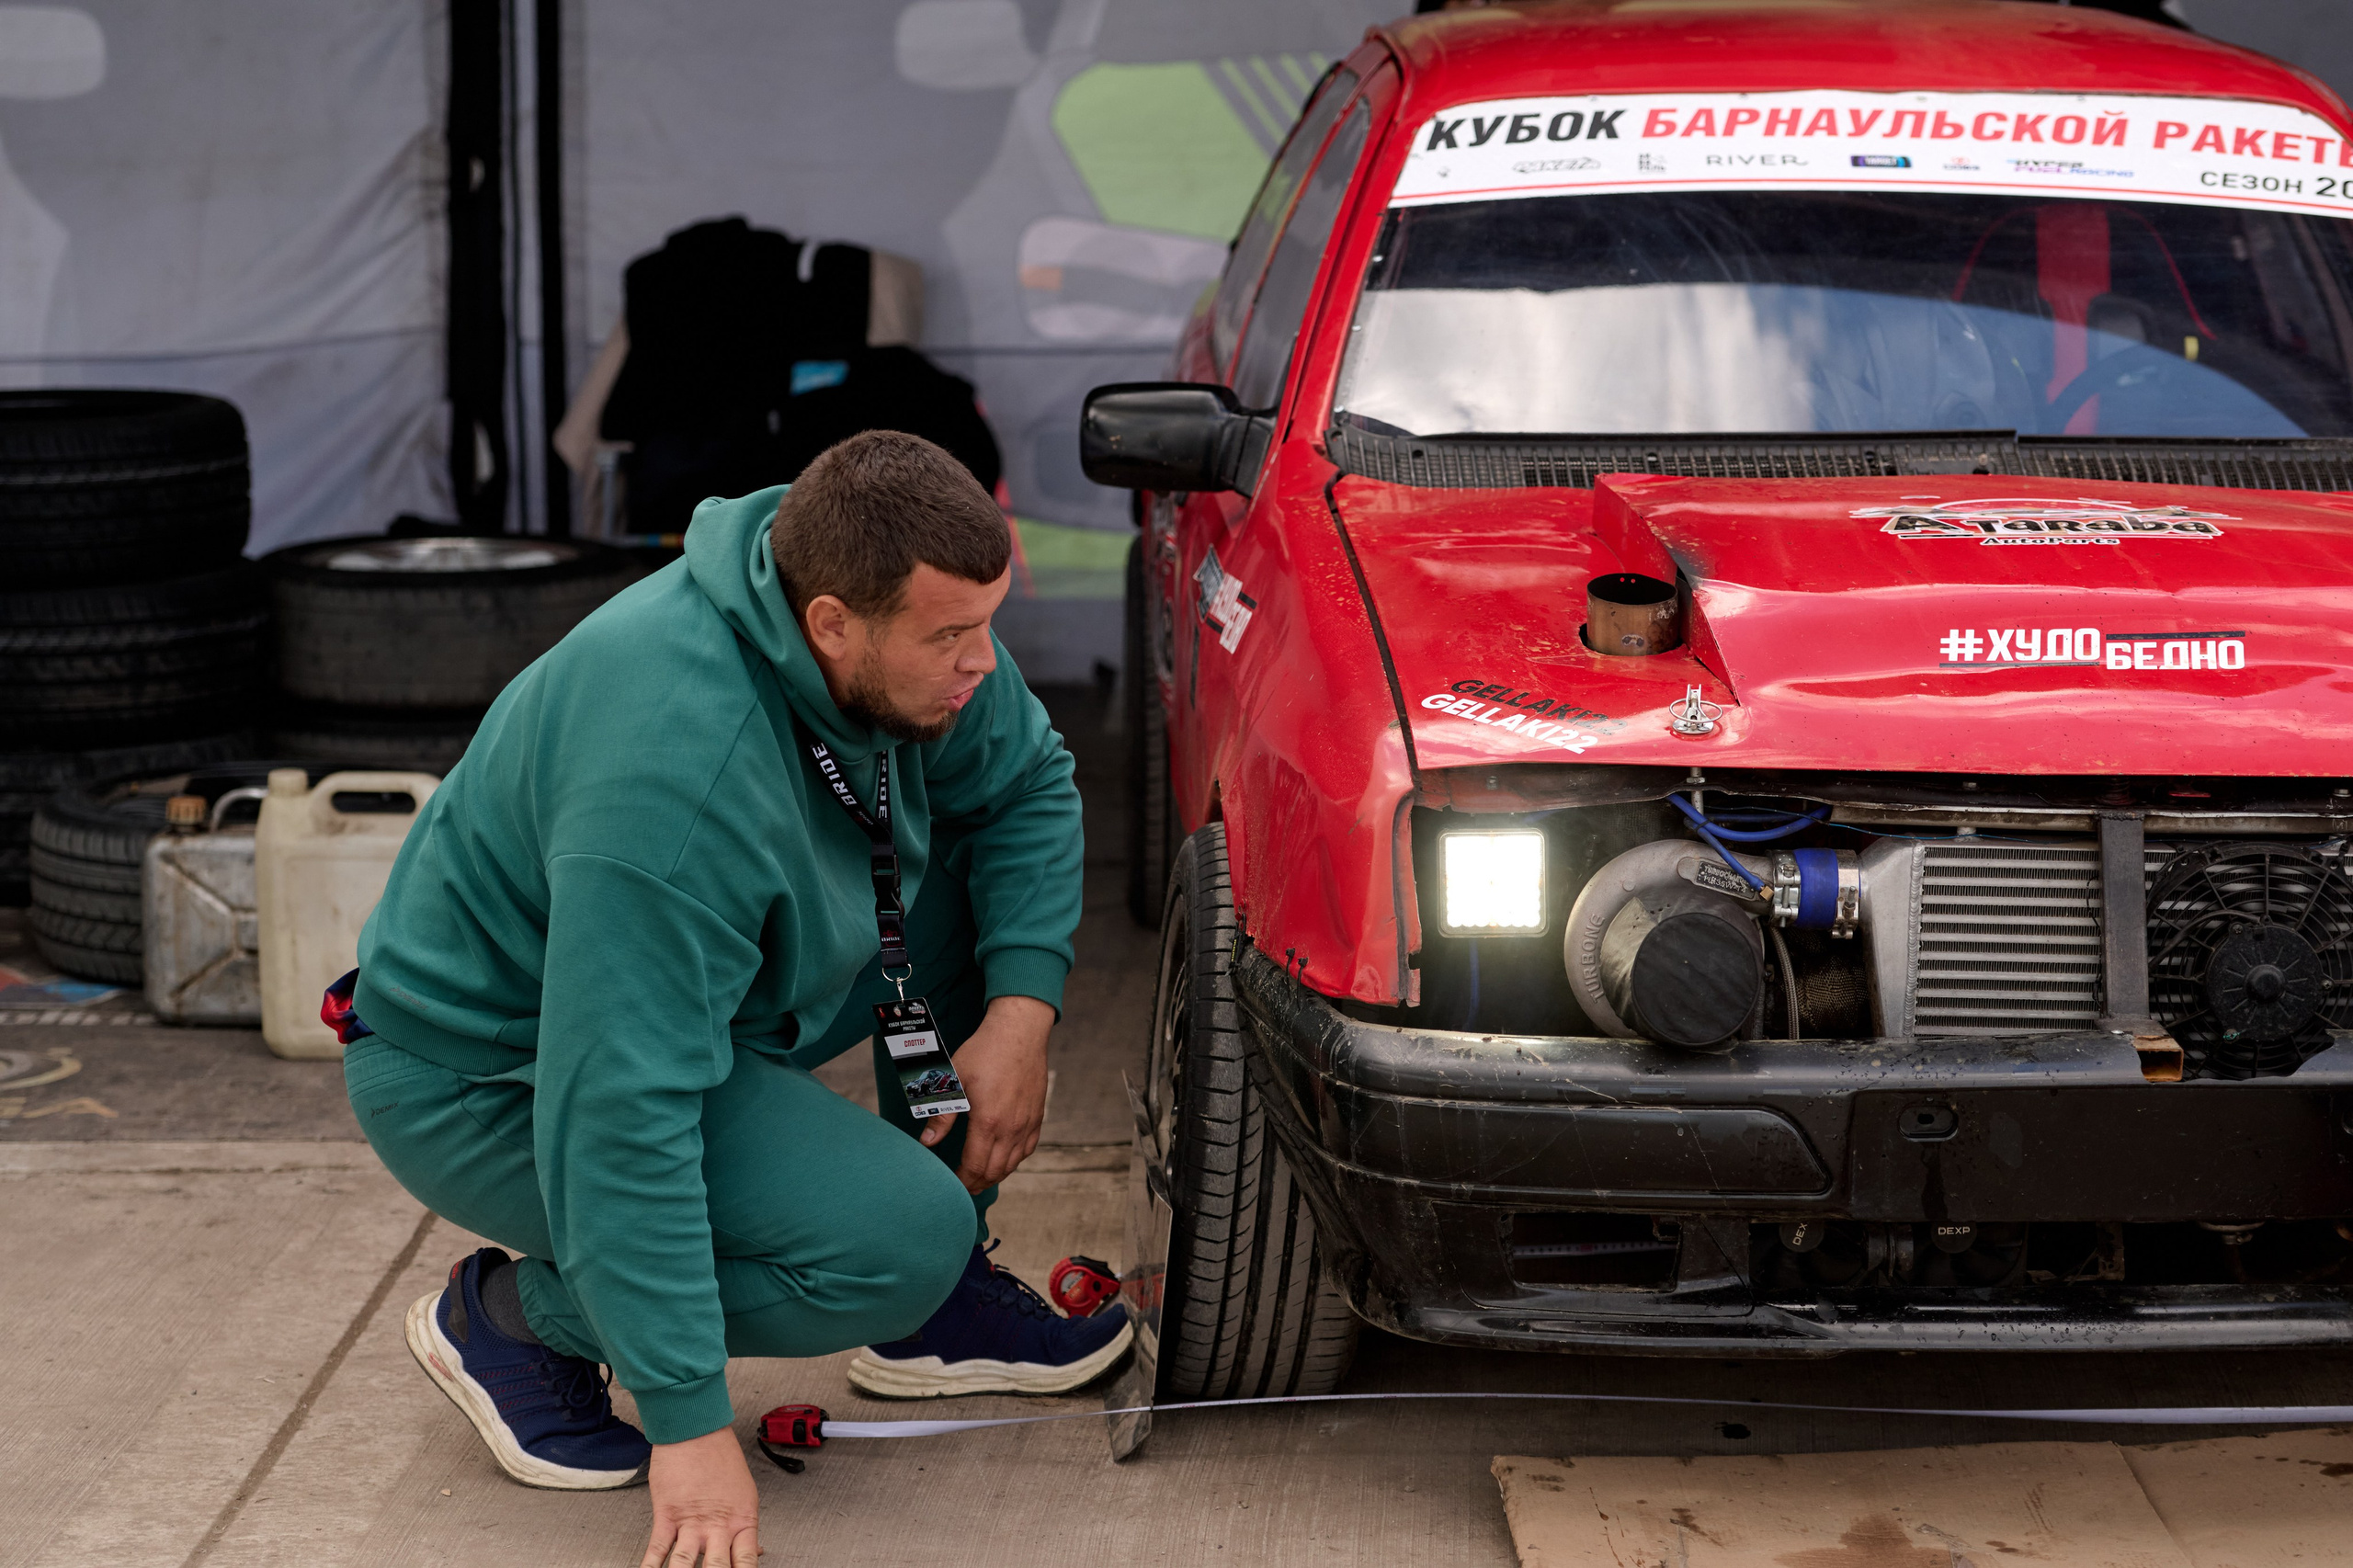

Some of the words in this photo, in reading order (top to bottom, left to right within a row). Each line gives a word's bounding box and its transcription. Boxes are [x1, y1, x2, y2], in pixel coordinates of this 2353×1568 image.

[1426, 108, 1626, 152] КУБОК
[1642, 108, 2130, 147] БАРНАУЛЬСКОЙ
[1706, 154, 1809, 166] RIVER
[2200, 171, 2302, 193] СЕЗОН
[1939, 628, 2101, 662] #ХУДО
[2106, 641, 2245, 670] БЕДНО
[1451, 679, 1628, 735] GELLAKI22
[1421, 694, 1598, 755] GELLAKI22
[812, 742, 858, 806] BRIDE
[1581, 913, 1606, 1005] TURBONE
[904, 1038, 926, 1048] СПОТТЕР
[376, 1101, 399, 1116] DEMIX
[1792, 1222, 1809, 1246] DEX
[1938, 1225, 1971, 1235] DEXP
